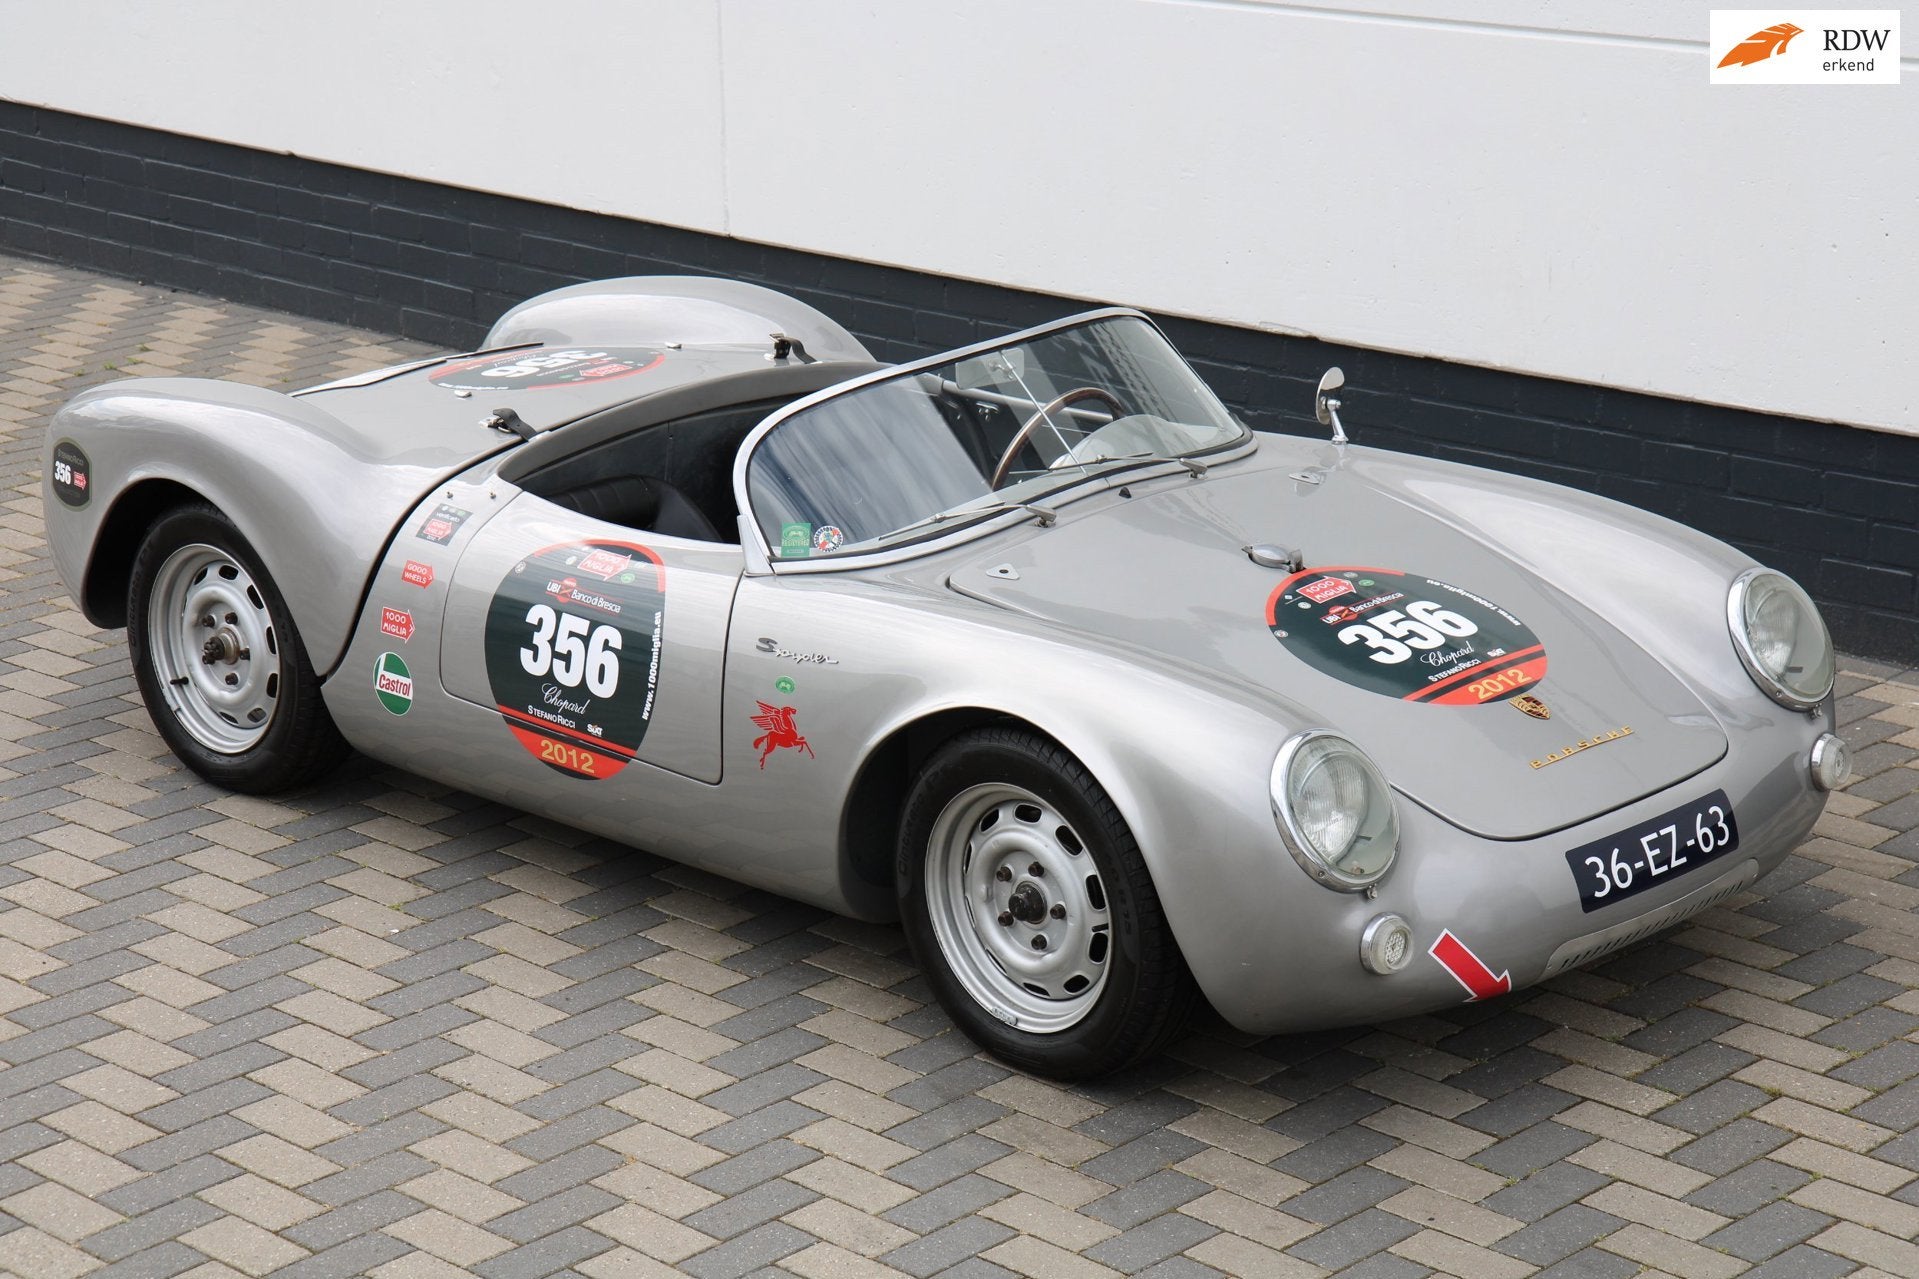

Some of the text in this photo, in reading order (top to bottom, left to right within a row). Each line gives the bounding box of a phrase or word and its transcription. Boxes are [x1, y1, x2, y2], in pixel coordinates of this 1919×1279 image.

[481, 350, 607, 378] 356
[54, 460, 72, 485] 356
[404, 571, 427, 584] WHEELS
[1306, 580, 1335, 594] 1000
[546, 581, 561, 593] UBI
[571, 589, 592, 604] Banco
[597, 597, 621, 613] Brescia
[1314, 585, 1349, 600] MIGLIA
[383, 622, 407, 636] MIGLIA
[385, 611, 407, 624] 1000
[1337, 600, 1479, 664] 356
[519, 603, 622, 699] 356
[755, 637, 839, 664] Spyder
[1420, 640, 1475, 667] Chopard
[641, 610, 662, 721] www.1000miglia.eu
[378, 674, 411, 697] Castrol
[1468, 669, 1532, 699] 2012
[541, 682, 591, 715] Chopard
[540, 739, 595, 774] 2012
[1529, 725, 1634, 770] PORSCHE
[1584, 805, 1730, 899] 36-EZ-63
